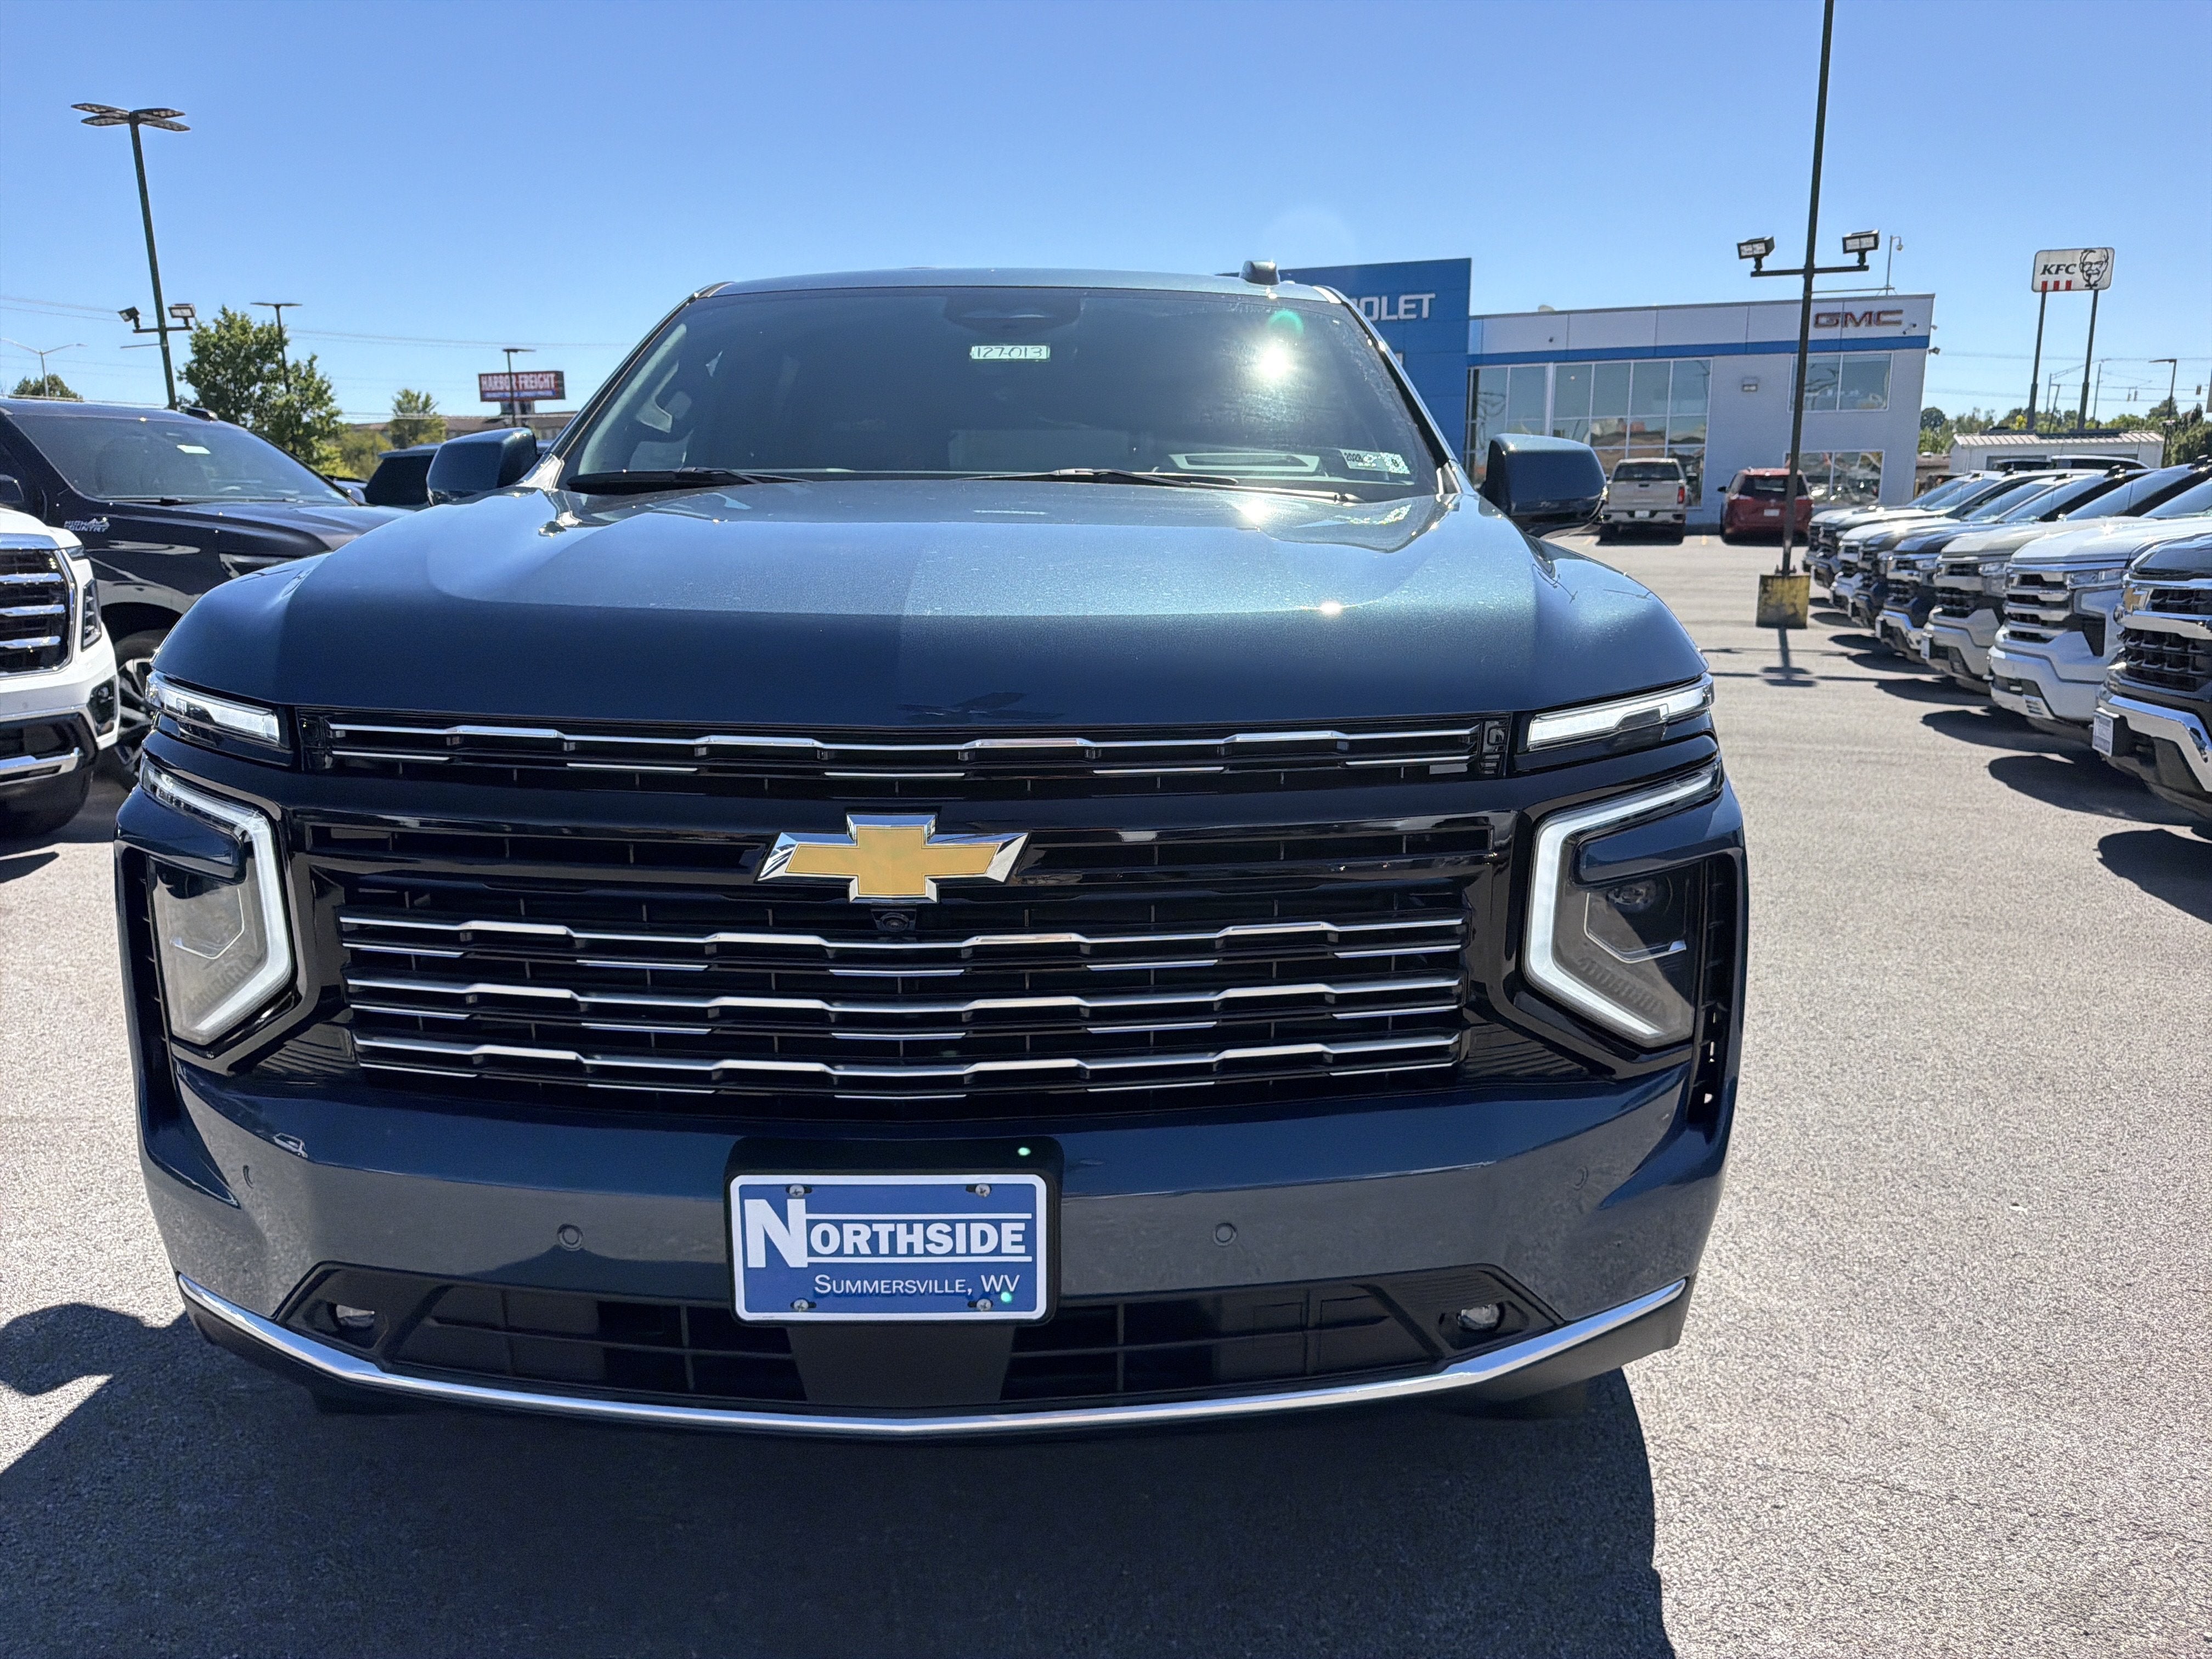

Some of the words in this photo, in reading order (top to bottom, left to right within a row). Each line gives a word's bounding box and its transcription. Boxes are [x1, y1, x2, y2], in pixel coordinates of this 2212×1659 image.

[2040, 263, 2076, 275] KFC
[1814, 309, 1903, 328] GMC
[978, 347, 1042, 358] 127-013
[744, 1199, 1025, 1268] NORTHSIDE
[814, 1274, 973, 1295] SUMMERSVILLE,
[981, 1274, 1020, 1293] WV
